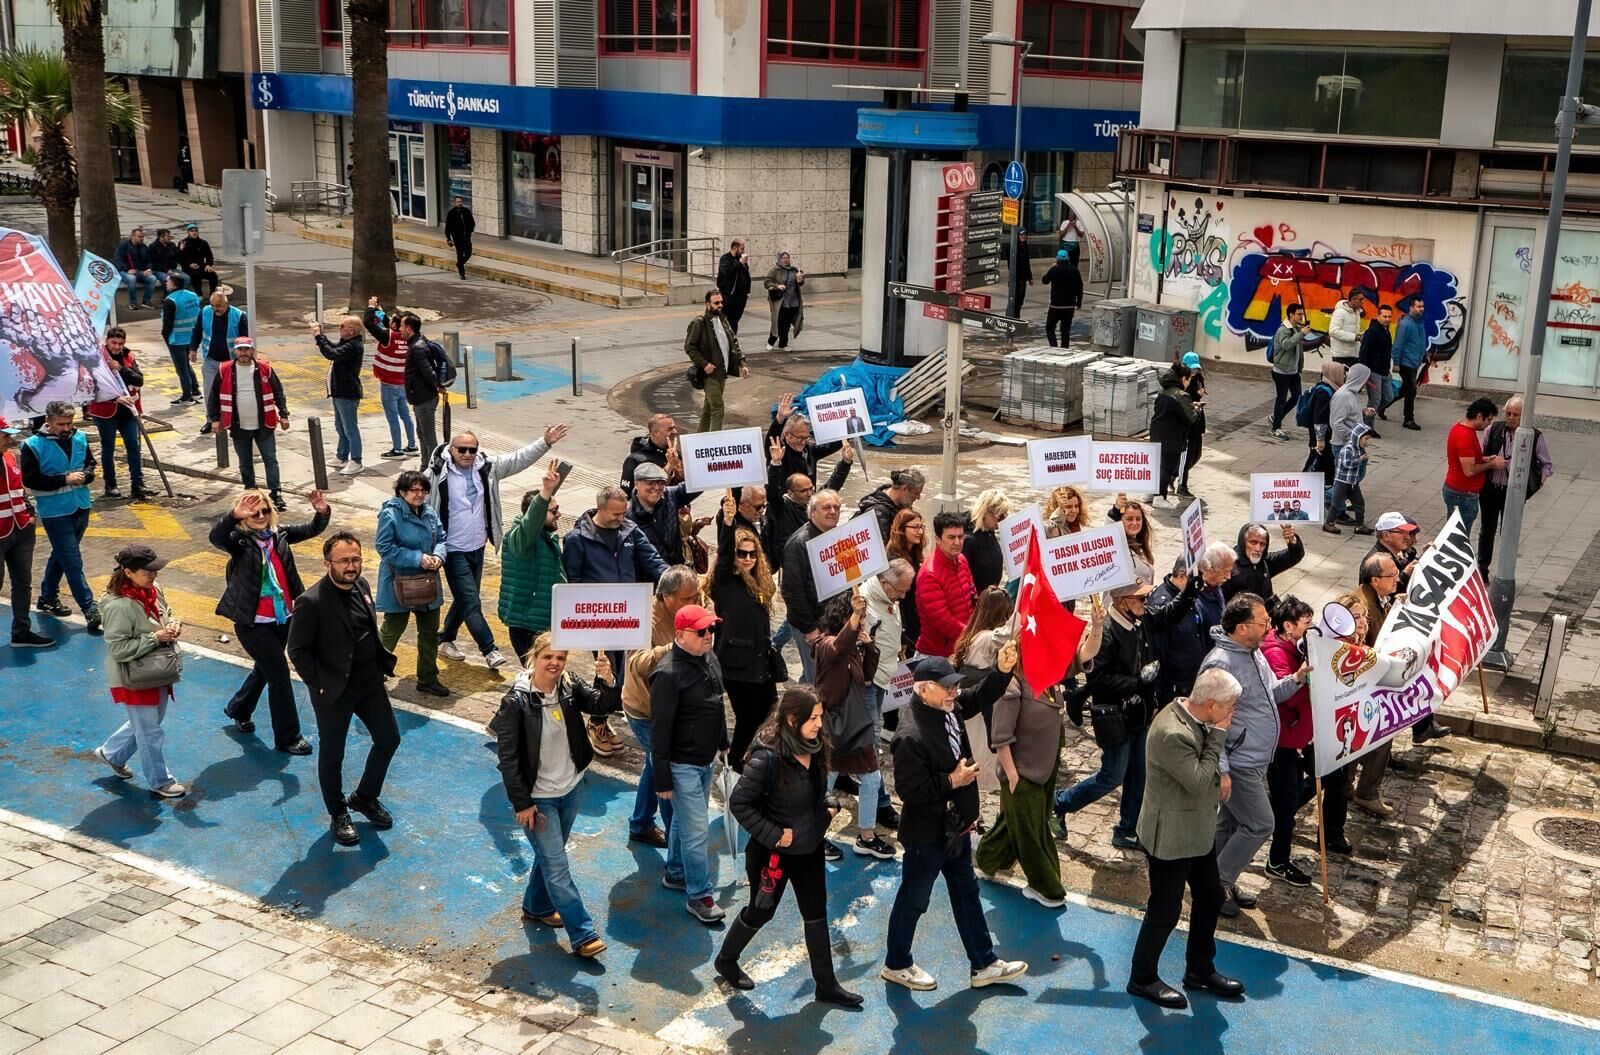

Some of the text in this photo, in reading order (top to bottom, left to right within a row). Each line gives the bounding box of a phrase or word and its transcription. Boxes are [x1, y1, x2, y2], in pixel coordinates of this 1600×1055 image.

[408, 89, 446, 109] TÜRKİYE
[457, 96, 500, 114] BANKASI
[900, 287, 919, 295] Liman
[817, 409, 849, 423] ÖZGÜRLÜK!
[695, 444, 752, 460] GERÇEKLERDEN
[1044, 450, 1077, 462] HABERDEN
[1098, 452, 1150, 465] GAZETECİLİK
[1096, 467, 1151, 483] SUÇ DEĞİLDİR
[1273, 478, 1300, 488] HAKİKAT
[1262, 490, 1311, 499] SUSTURULAMAZ
[819, 528, 871, 563] GAZETECİLERE
[1081, 535, 1114, 553] ULUSUN
[828, 548, 870, 577] ÖZGÜRLÜK!
[1051, 561, 1079, 576] ORTAK
[575, 600, 627, 617] GERÇEKLERİ
